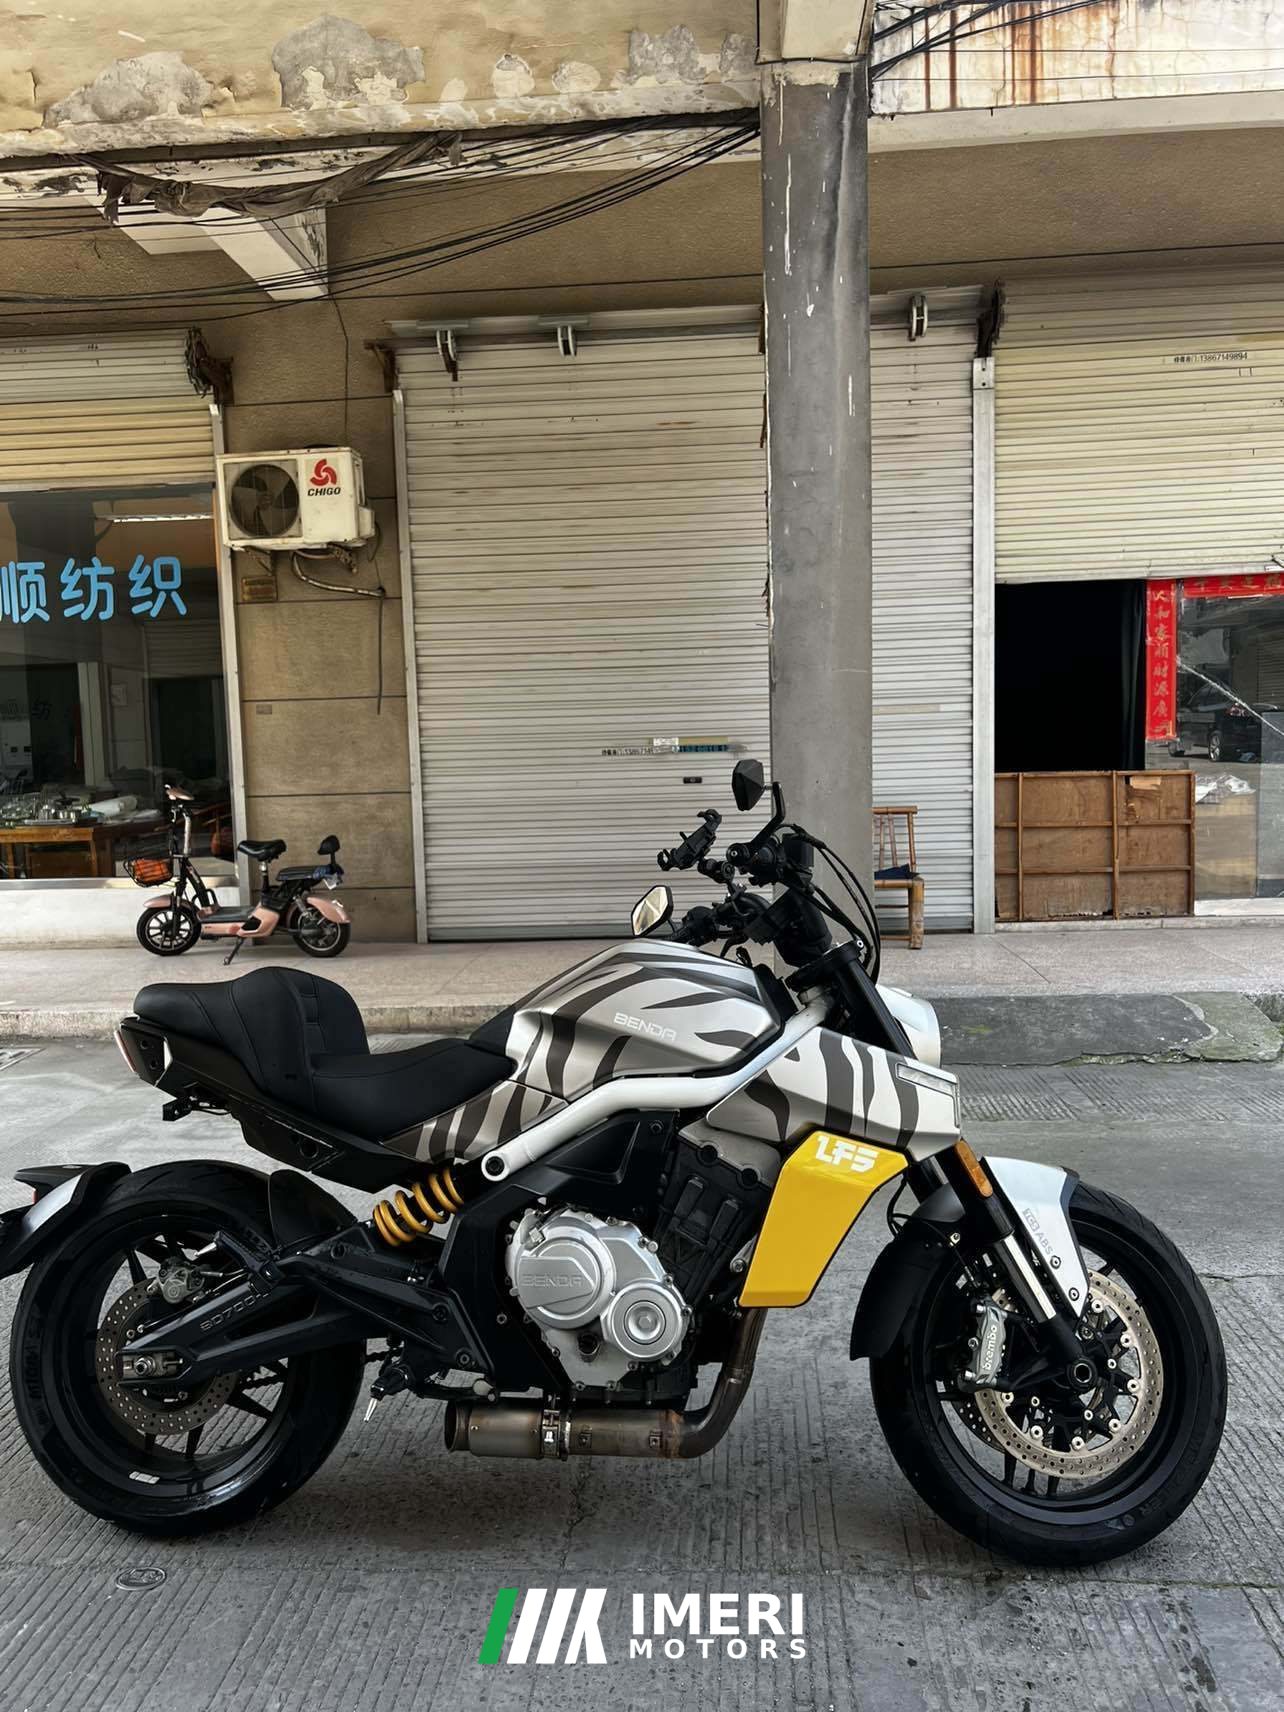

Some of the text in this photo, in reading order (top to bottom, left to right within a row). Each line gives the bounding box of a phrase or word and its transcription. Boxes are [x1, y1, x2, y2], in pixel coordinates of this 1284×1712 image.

[307, 487, 341, 497] CHIGO
[0, 554, 188, 624] 顺纺织
[613, 1012, 677, 1042] BENDA
[1034, 1232, 1053, 1255] ABS
[982, 1324, 998, 1371] brembo
